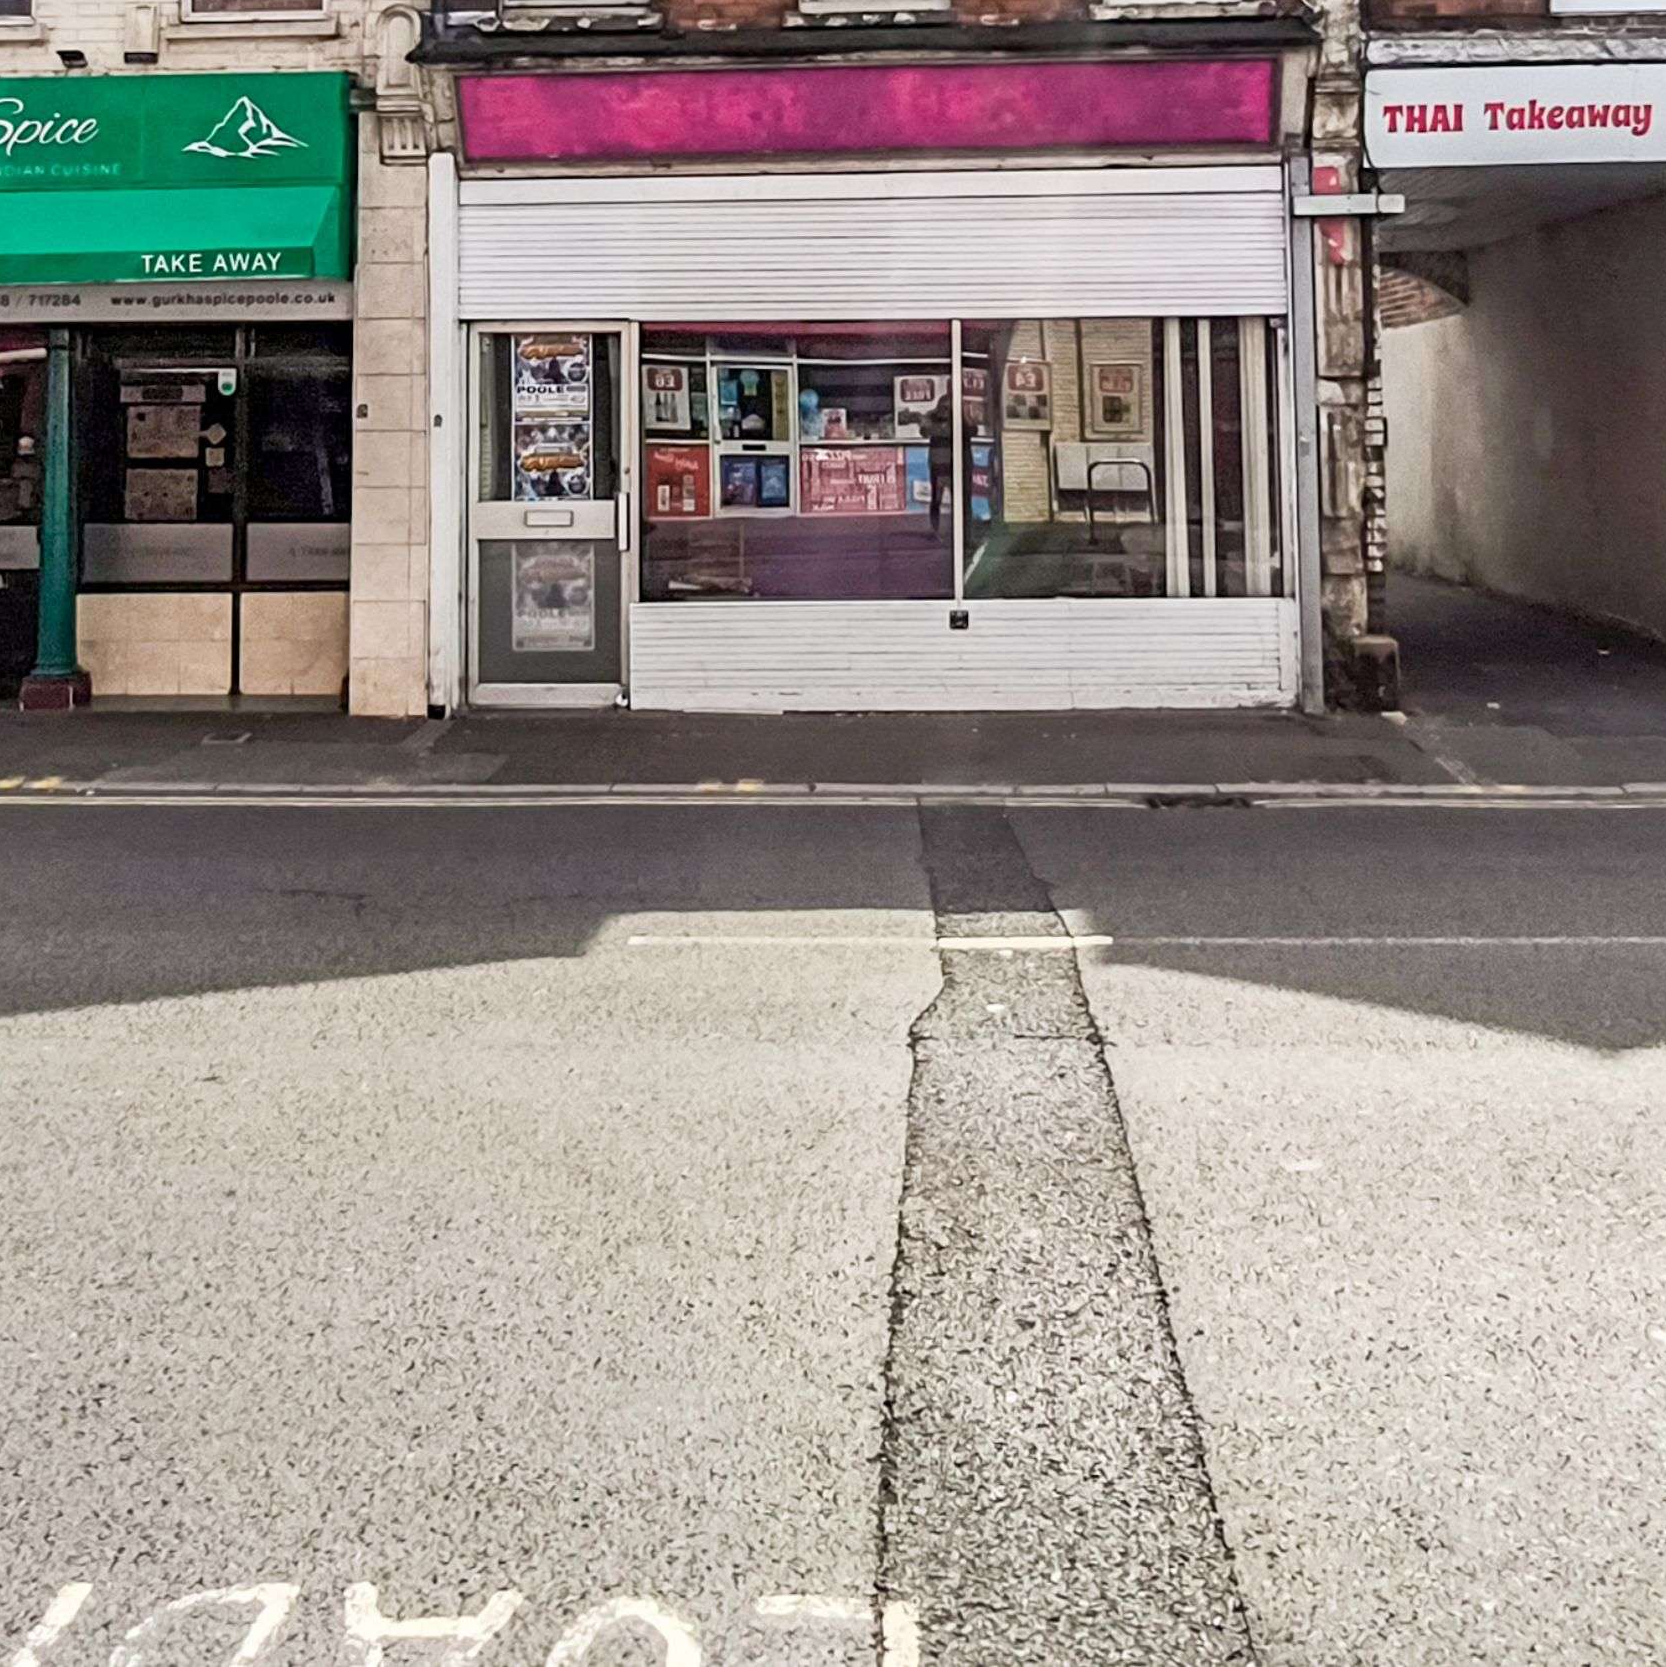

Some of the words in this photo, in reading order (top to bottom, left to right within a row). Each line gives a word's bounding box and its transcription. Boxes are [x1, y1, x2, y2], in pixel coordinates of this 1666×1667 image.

[1382, 103, 1464, 133] THAI
[1484, 99, 1653, 136] Takeaway
[51, 162, 121, 176] CUISINE
[141, 253, 203, 273] TAKE
[213, 252, 282, 272] AWAY
[29, 293, 81, 307] 717284
[111, 291, 335, 308] www.gurkhaspicepoole.co.uk
[516, 385, 566, 394] POOLE
